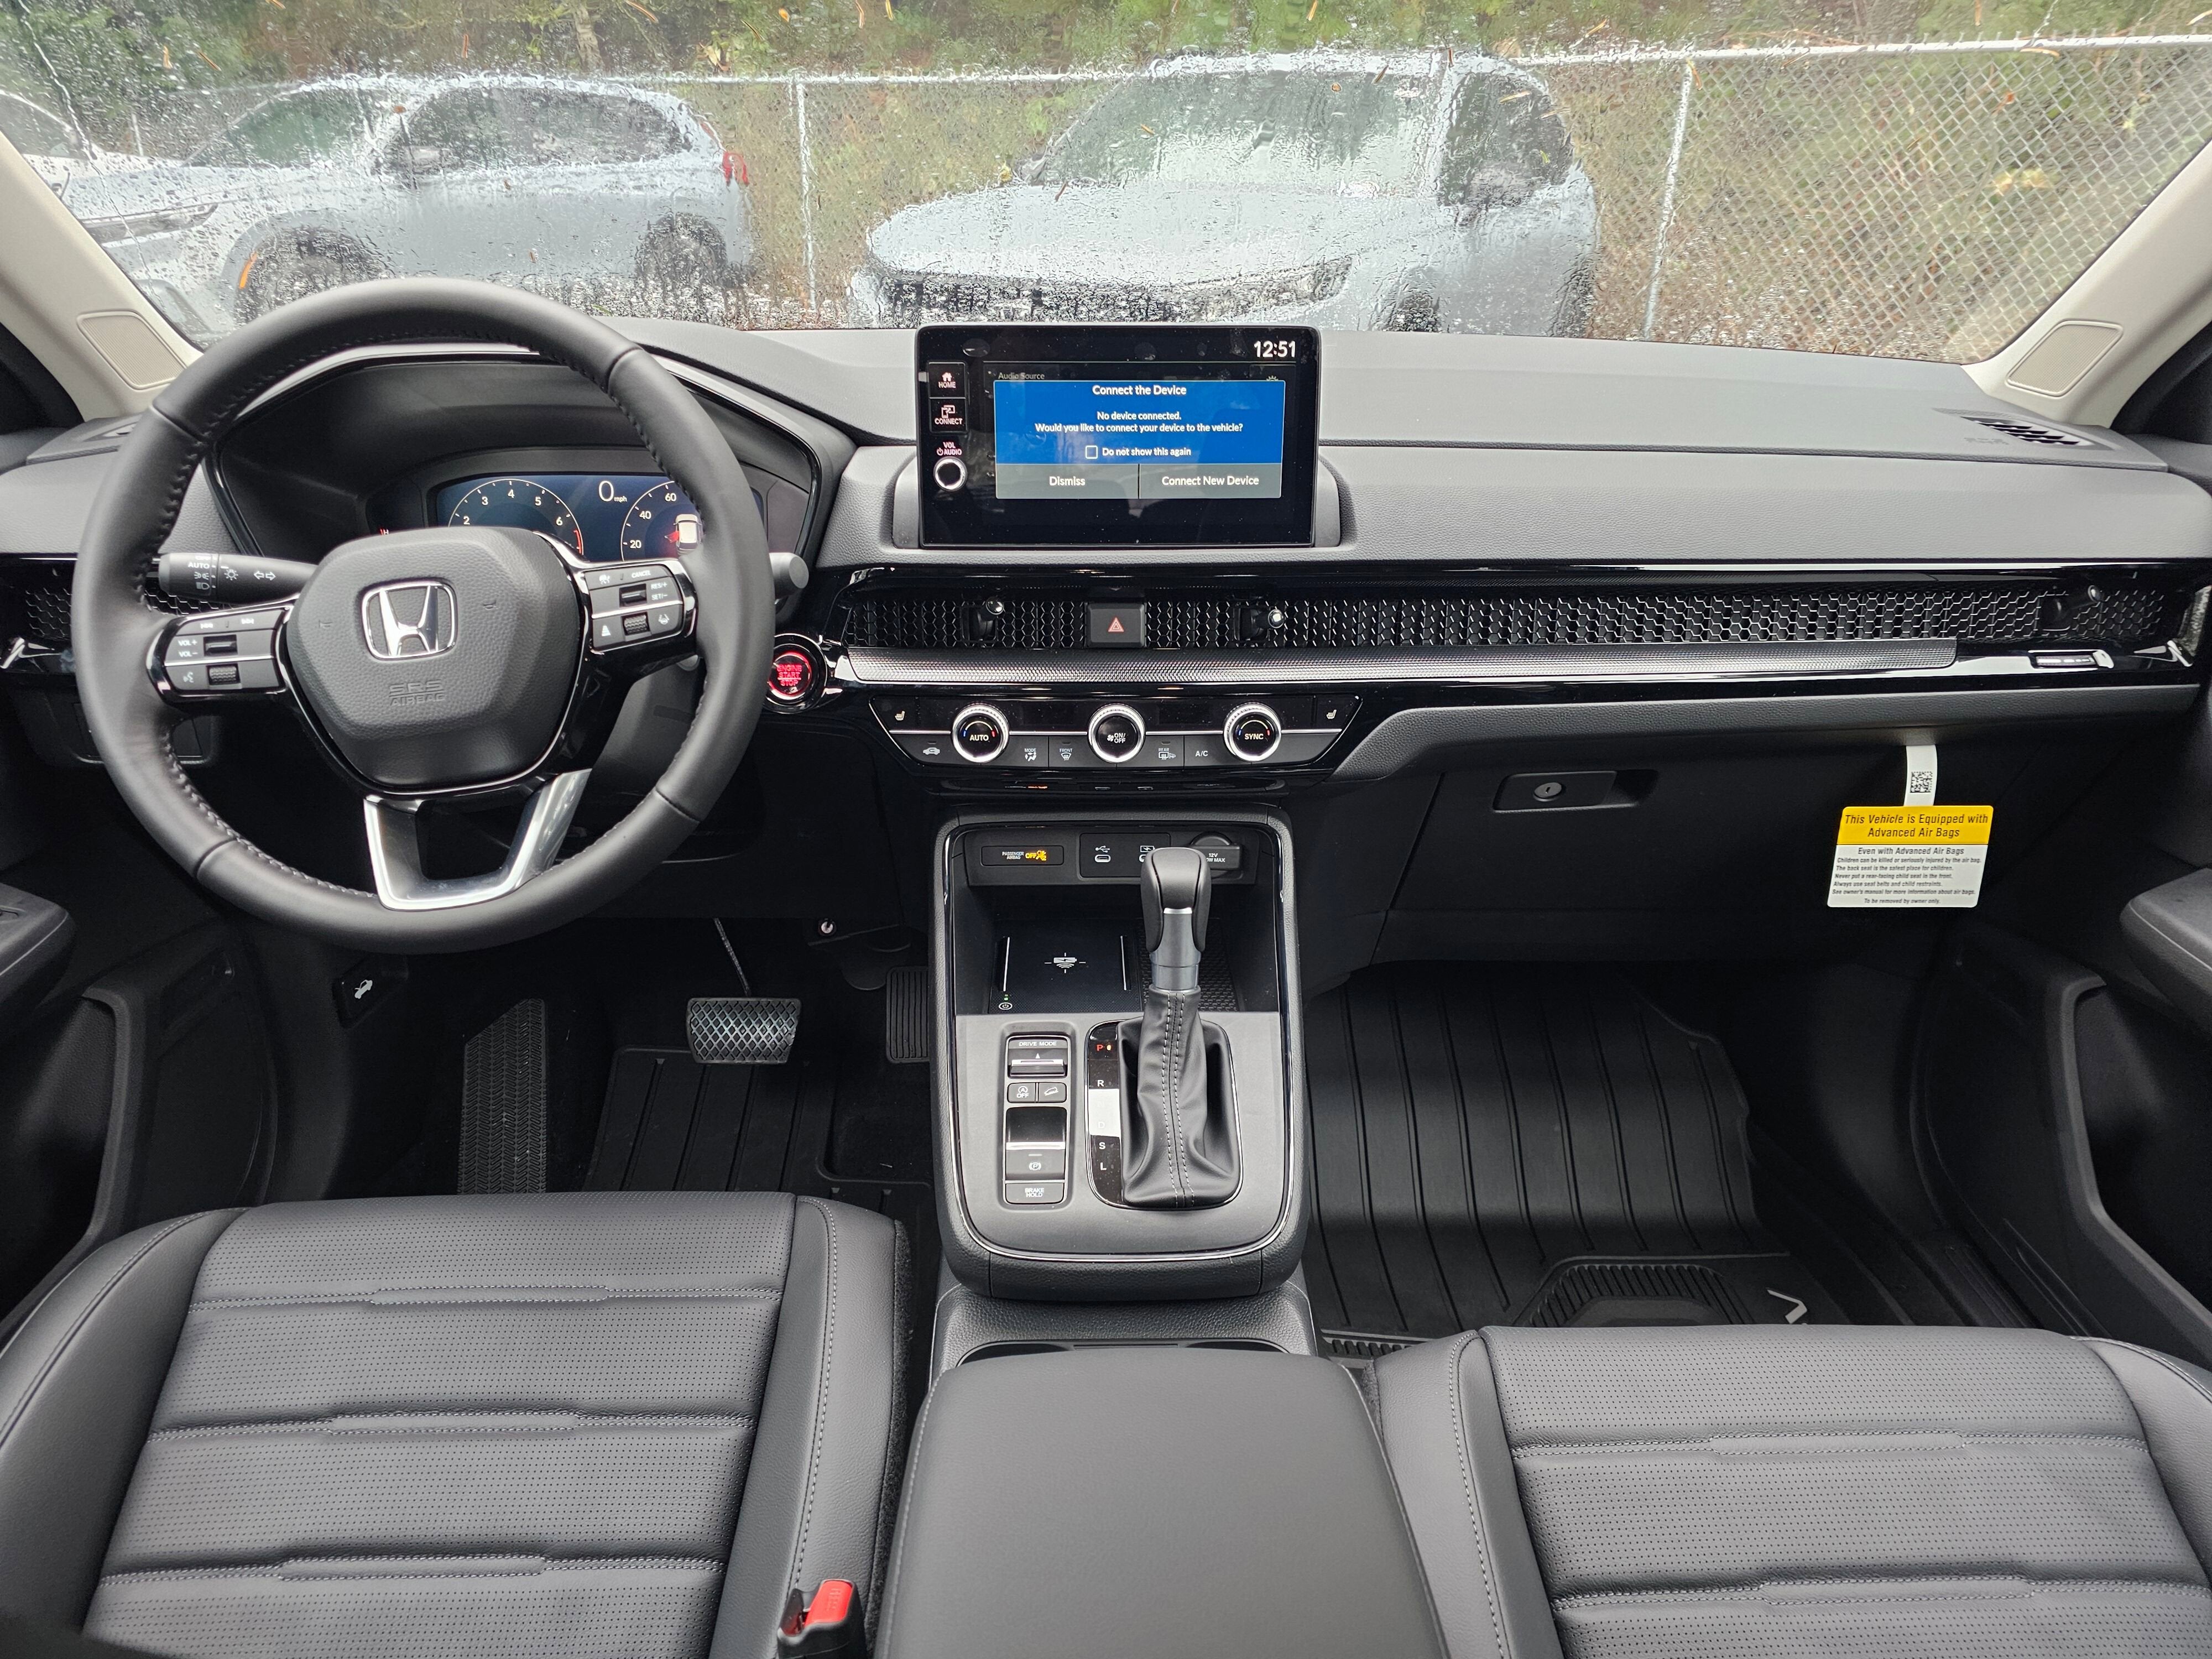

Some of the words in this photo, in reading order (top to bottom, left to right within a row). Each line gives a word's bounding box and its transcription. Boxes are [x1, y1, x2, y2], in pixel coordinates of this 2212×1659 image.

[1254, 341, 1296, 357] 12:51
[1092, 385, 1133, 395] Connect
[1135, 385, 1151, 395] the
[1153, 385, 1187, 395] Device
[1097, 411, 1110, 420] No
[1111, 411, 1136, 420] device
[1138, 411, 1182, 420] connected.
[1035, 423, 1062, 432] Would
[1063, 425, 1078, 433] you
[1080, 423, 1094, 432] like
[1095, 424, 1105, 432] to
[1106, 424, 1138, 432] connect
[1139, 424, 1158, 434] your
[1160, 423, 1185, 432] device
[1186, 424, 1196, 432] to
[1197, 423, 1210, 432] the
[1211, 423, 1244, 432] vehicle?
[1102, 447, 1114, 456] Do
[1115, 447, 1130, 456] not
[1131, 447, 1152, 456] show
[1154, 447, 1168, 456] this
[1170, 447, 1192, 457] again
[1050, 476, 1086, 486] Dismiss
[1162, 476, 1201, 486] Connect
[1203, 476, 1225, 486] New
[1227, 476, 1260, 486] Device
[508, 489, 515, 498] 4
[598, 481, 614, 502] 0
[482, 497, 488, 505] 3
[535, 497, 542, 506] 5
[665, 493, 677, 502] 60
[639, 510, 651, 519] 40
[463, 516, 470, 525] 2
[556, 517, 563, 526] 6
[630, 540, 642, 549] 20
[632, 570, 651, 579] CANCEL
[389, 680, 442, 694] SRS
[389, 693, 445, 707] AIRBAG
[1845, 815, 1865, 823] This
[1869, 815, 1903, 823] Vehicle
[1907, 814, 1916, 823] is
[1919, 814, 1965, 825] Equipped
[1968, 814, 1989, 823] with
[1867, 828, 1916, 837] Advanced
[1918, 828, 1933, 837] Air
[1936, 828, 1960, 839] Bags
[1945, 847, 1964, 856] Bags
